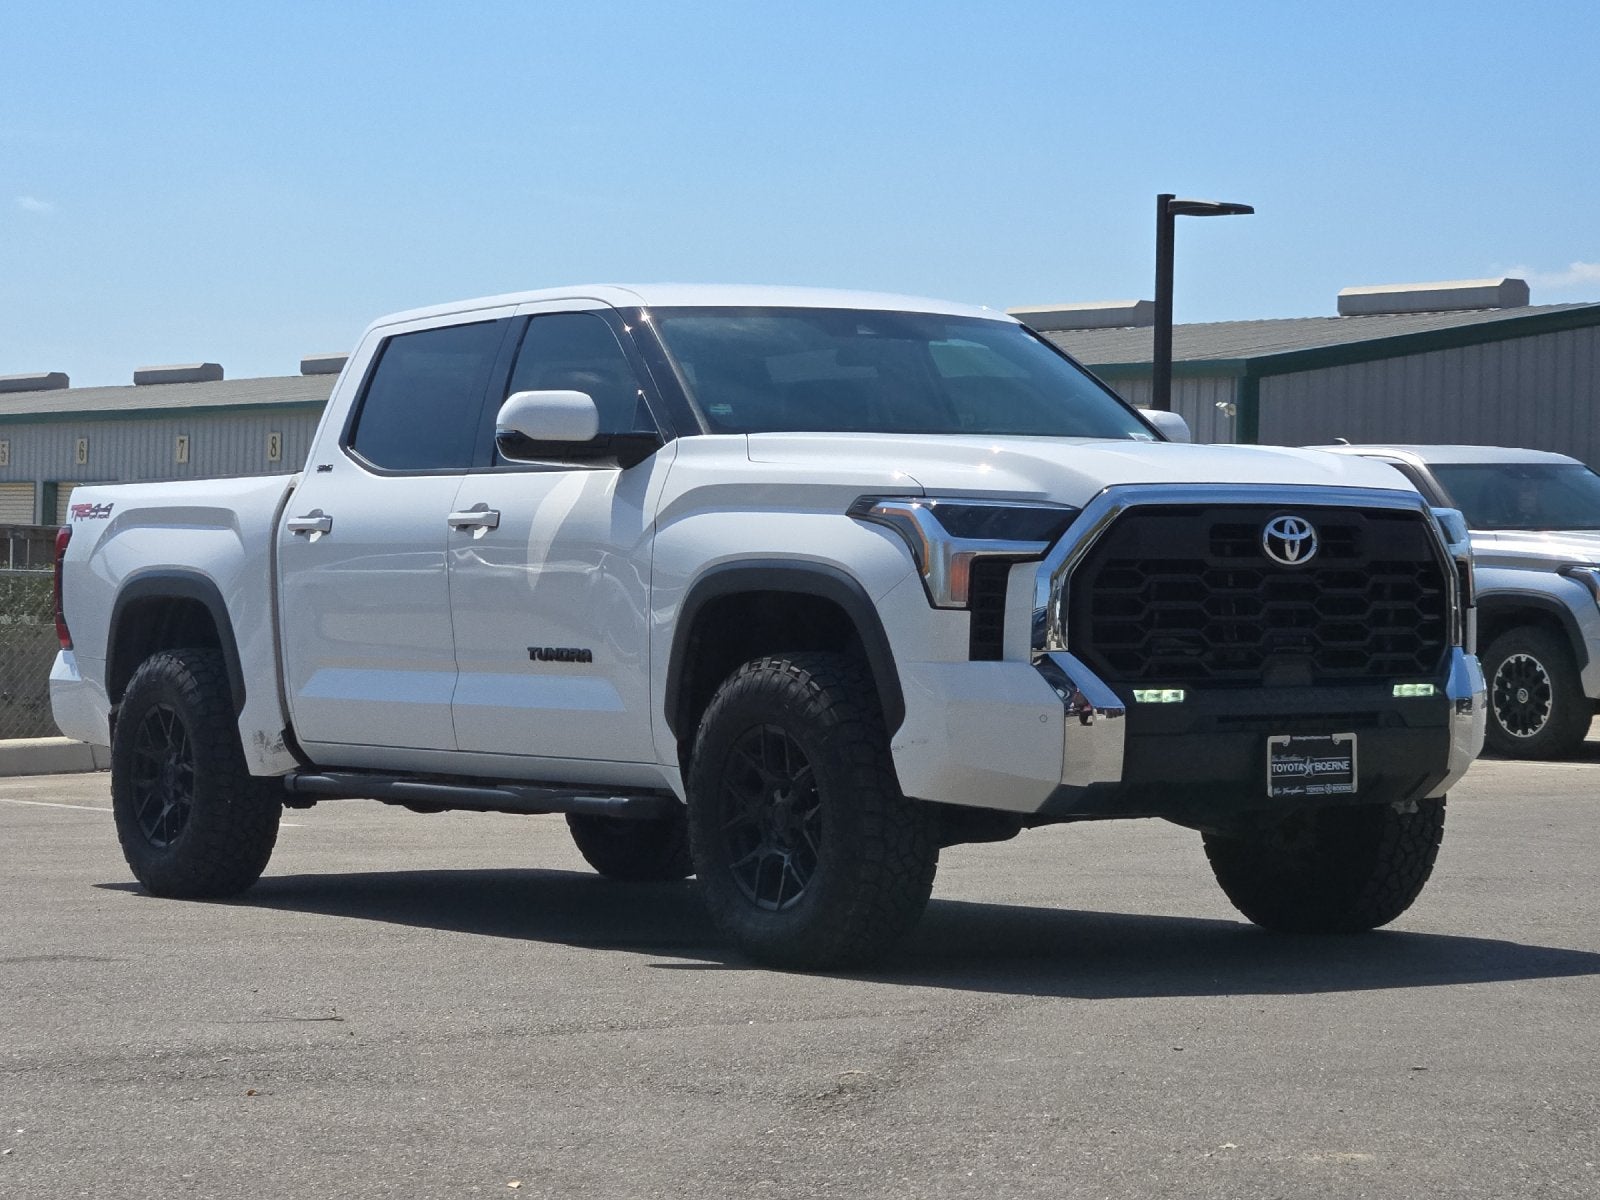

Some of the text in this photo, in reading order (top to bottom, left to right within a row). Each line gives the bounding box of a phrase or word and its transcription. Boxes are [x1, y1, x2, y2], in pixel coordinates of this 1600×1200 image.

[79, 440, 85, 461] 6
[179, 439, 186, 460] 7
[270, 436, 277, 458] 8
[527, 647, 593, 663] TUNDRA
[1272, 760, 1350, 773] TOYOTA BOERNE
